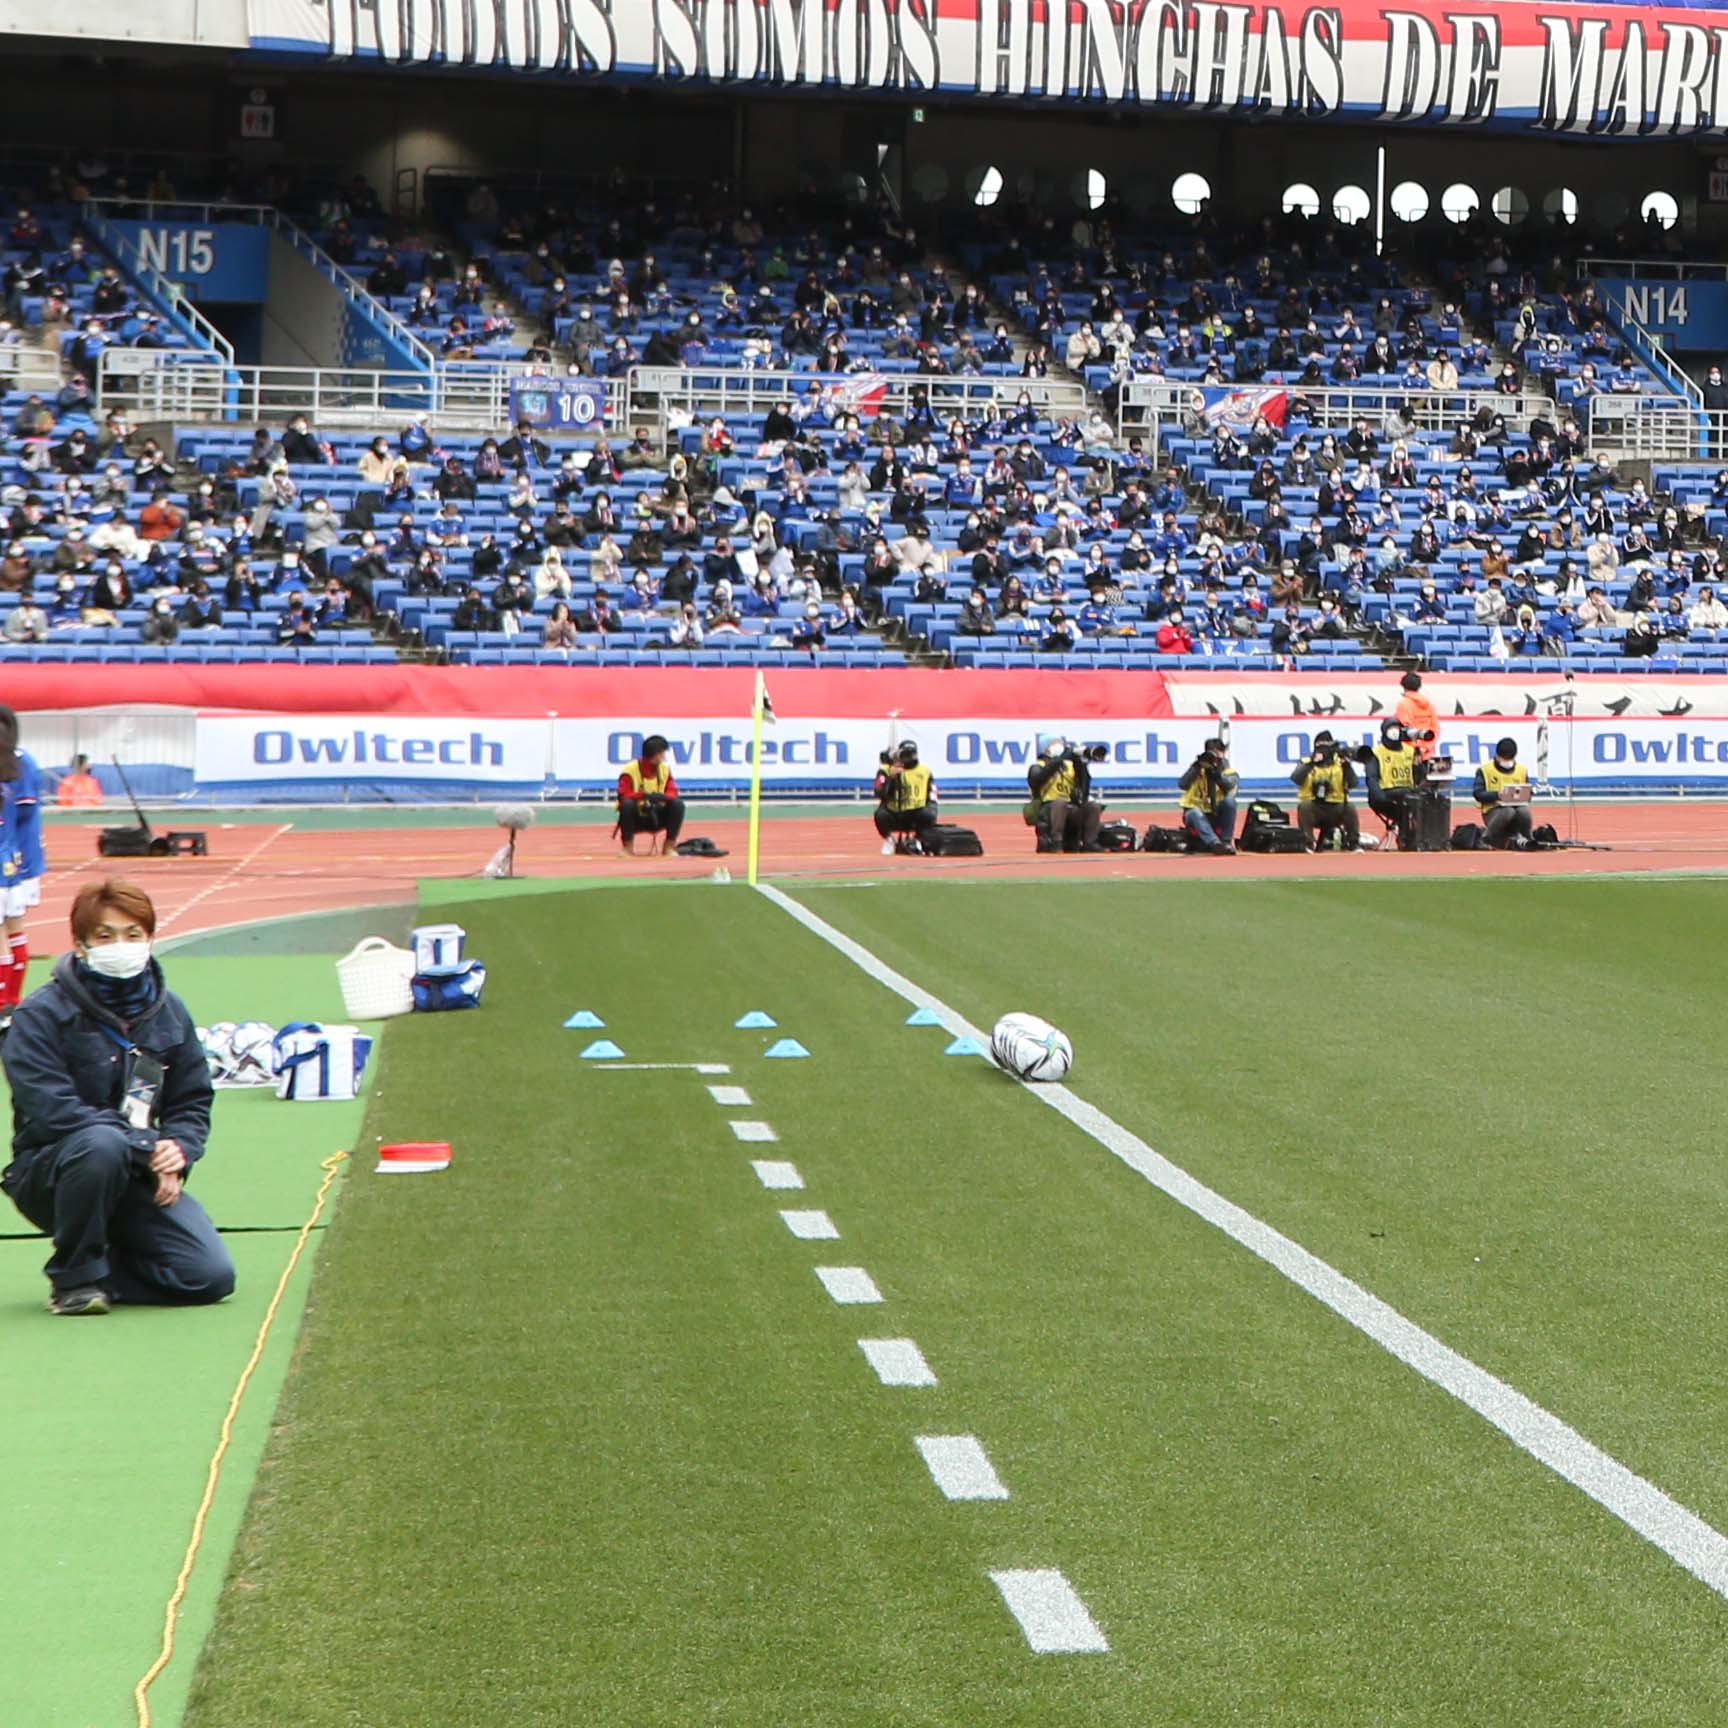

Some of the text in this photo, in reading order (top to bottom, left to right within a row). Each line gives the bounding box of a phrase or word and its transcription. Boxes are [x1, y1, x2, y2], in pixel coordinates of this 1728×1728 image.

[1384, 10, 1500, 122] DE
[136, 227, 215, 274] N15
[1624, 285, 1688, 325] N14
[559, 393, 596, 424] 10
[253, 729, 504, 768] Owltech
